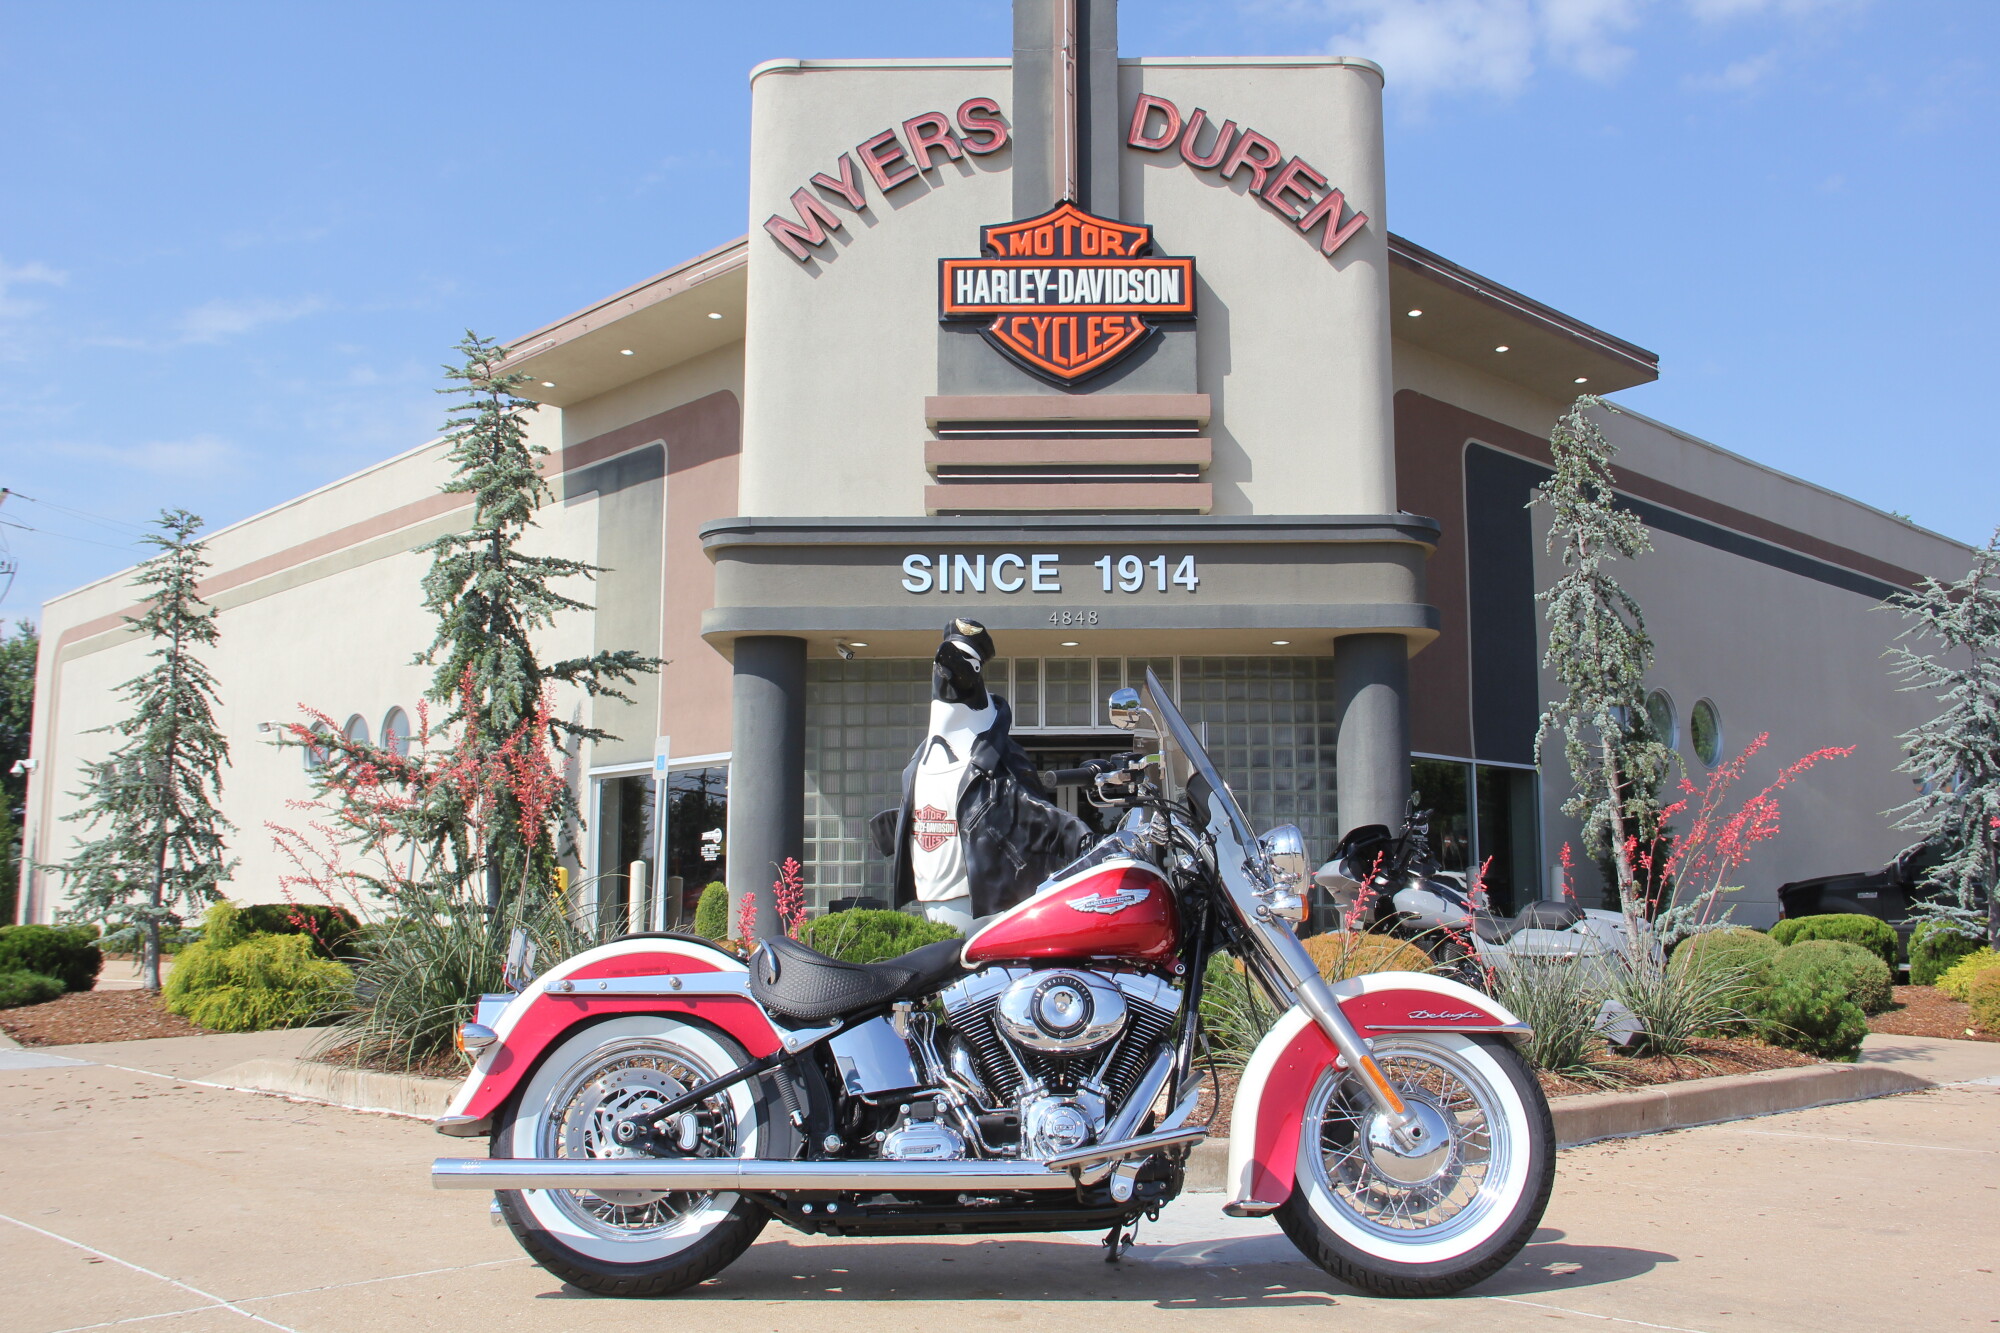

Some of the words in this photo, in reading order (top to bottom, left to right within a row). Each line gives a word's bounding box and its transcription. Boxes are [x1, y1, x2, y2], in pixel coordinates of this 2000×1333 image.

[763, 97, 1009, 263] MYERS
[1127, 93, 1369, 258] DUREN
[1009, 216, 1124, 257] MOTOR
[956, 268, 1180, 305] HARLEY-DAVIDSON
[1008, 315, 1125, 367] CYCLES
[901, 554, 1061, 594] SINCE
[1094, 554, 1200, 594] 1914
[1048, 610, 1100, 627] 4848
[1408, 1010, 1484, 1021] Deluxe
